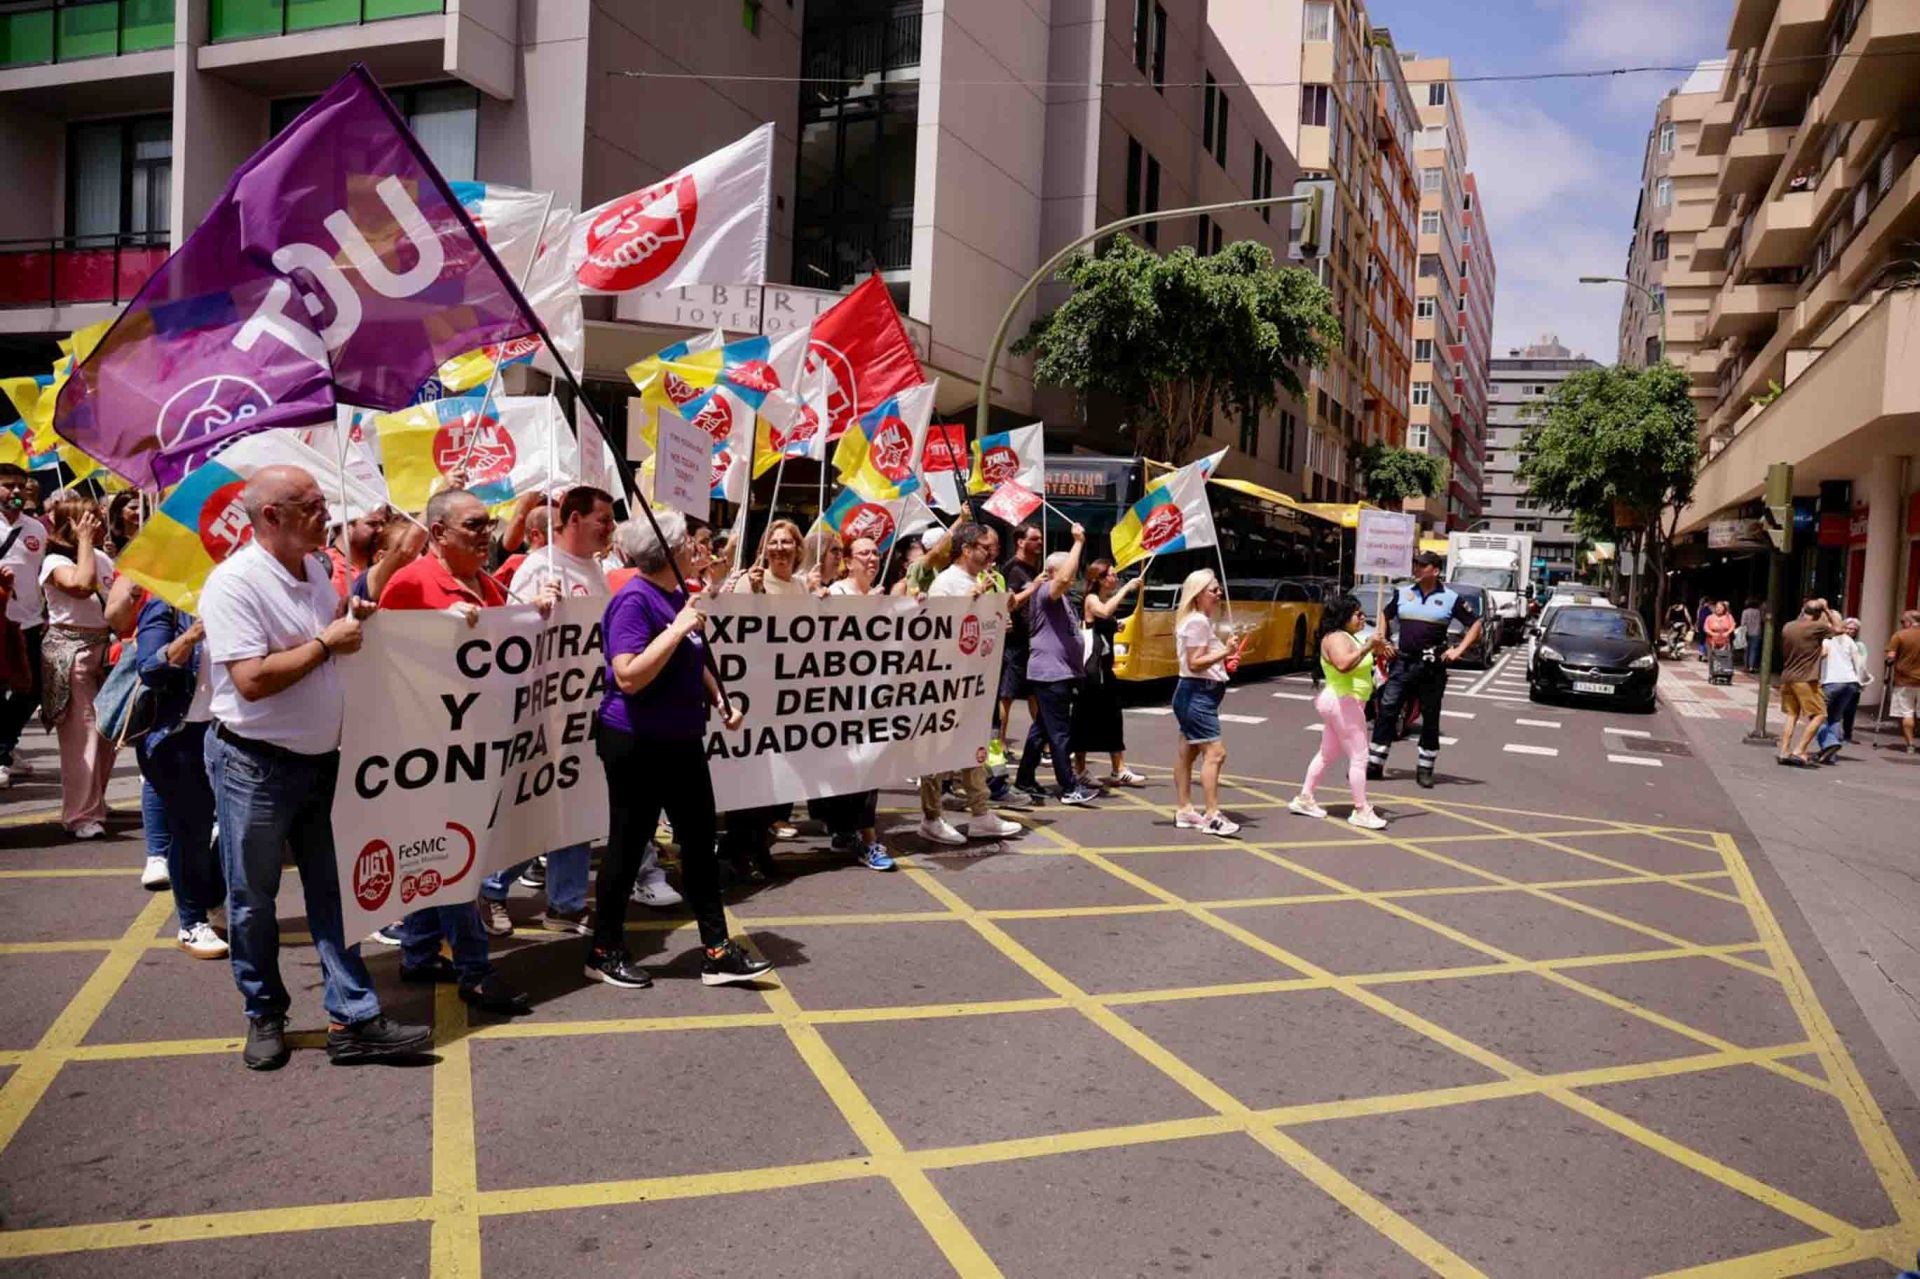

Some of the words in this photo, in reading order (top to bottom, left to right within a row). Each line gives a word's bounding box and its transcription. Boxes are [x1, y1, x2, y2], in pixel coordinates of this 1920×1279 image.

[642, 284, 829, 314] LBERT
[456, 621, 604, 679] CONTRA
[709, 608, 952, 644] XPLOTACIÓN
[440, 692, 481, 731] Y
[513, 665, 608, 724] PRECA
[774, 648, 953, 681] LABORAL.
[354, 723, 548, 800] CONTRA
[775, 673, 986, 716] DENIGRANTE
[514, 754, 581, 806] LOS
[705, 708, 960, 761] AJADORES/AS.
[358, 846, 390, 886] UGT
[398, 836, 448, 860] FeSMC
